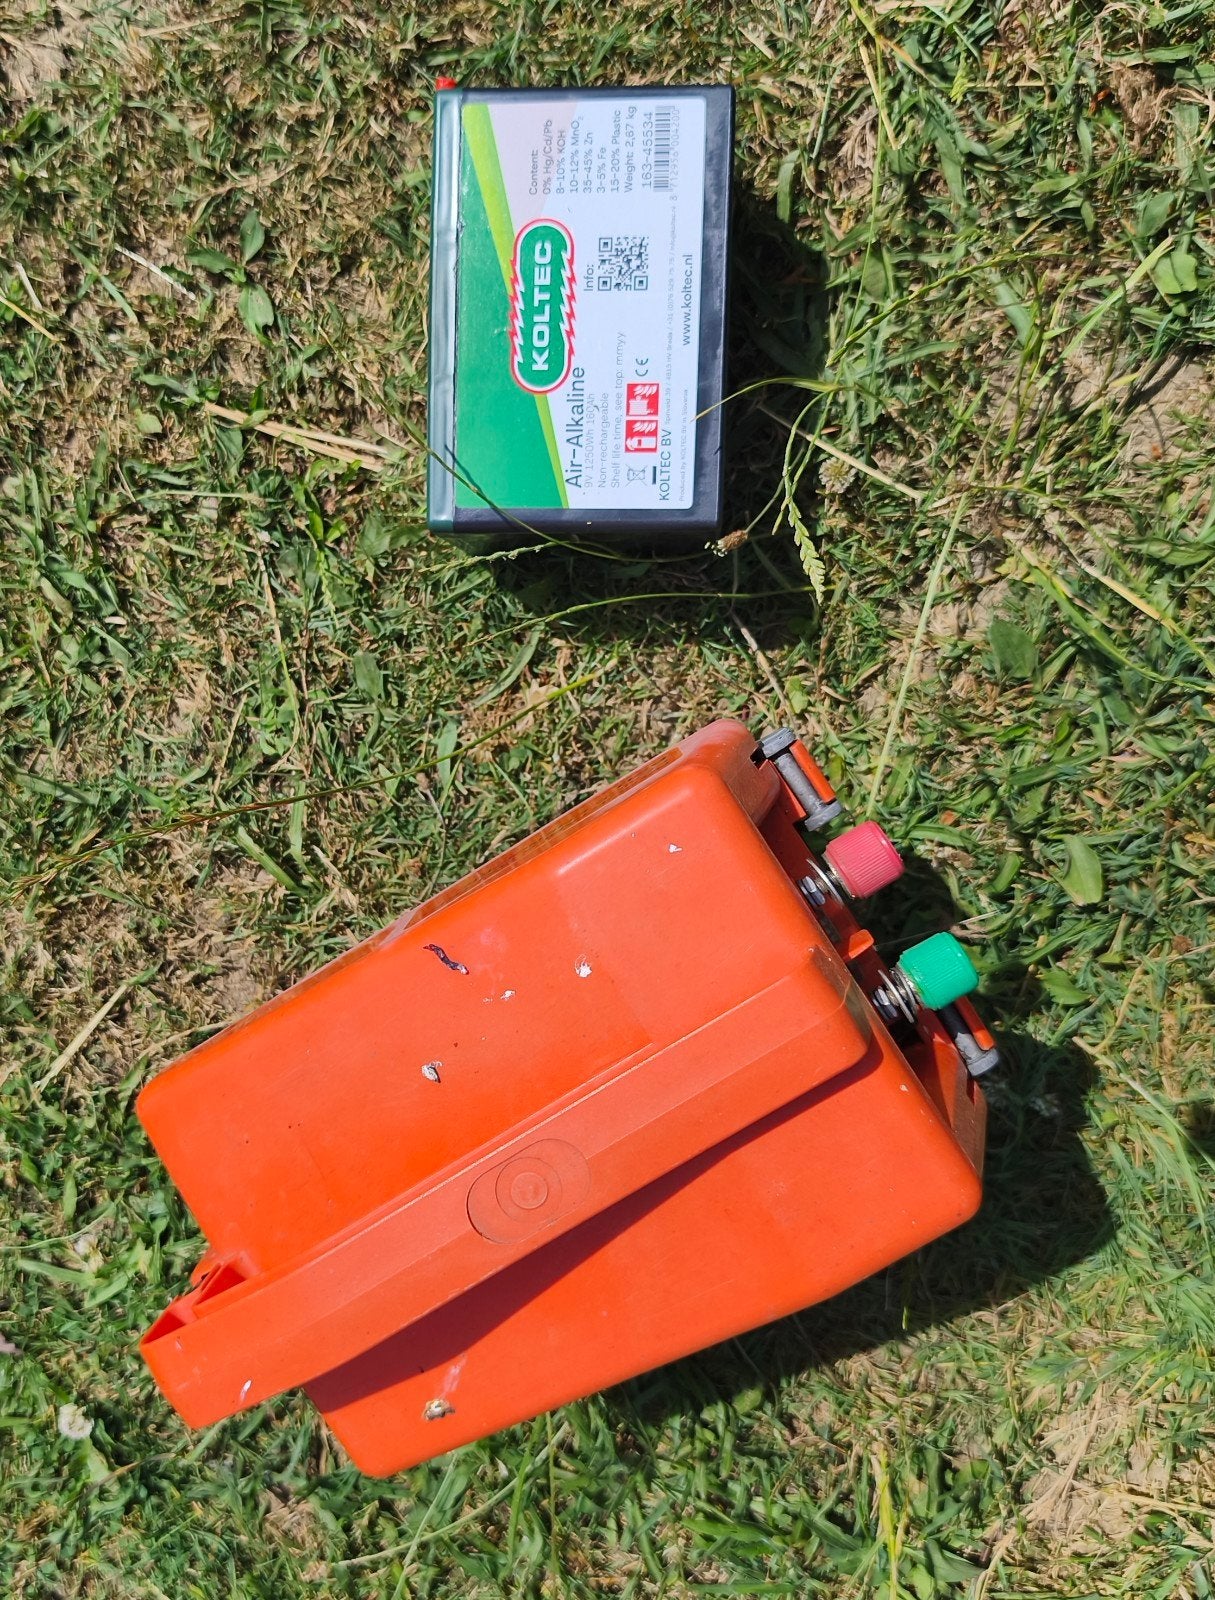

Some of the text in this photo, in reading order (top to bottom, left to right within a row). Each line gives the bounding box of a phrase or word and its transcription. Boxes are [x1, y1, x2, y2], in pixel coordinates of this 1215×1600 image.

[626, 107, 637, 119] kg
[529, 150, 538, 195] Content:
[543, 120, 554, 194] 0% Hg/Cd/Pb
[556, 130, 565, 194] 8-10% KOH
[570, 150, 579, 193] 10-12%
[583, 132, 593, 193] 35-45% Zn
[597, 148, 606, 193] 3-5% Fe
[611, 110, 620, 193] 15-20% Plastic
[624, 152, 635, 192] Weight:
[642, 112, 653, 189] 163-45534
[584, 264, 594, 291] Info:
[681, 254, 693, 346] www.koltec.nl
[532, 240, 551, 371] KOLTEC
[616, 332, 625, 365] mmyy
[615, 369, 624, 389] top:
[565, 367, 585, 488] Air-Alkaline
[585, 429, 594, 470] 1250Wh
[598, 393, 610, 488] Non-rechargeable
[613, 415, 622, 439] time,
[612, 444, 621, 458] life
[659, 429, 671, 500] KOLTEC BV
[585, 475, 593, 487] 9V
[611, 463, 620, 488] Shelf
